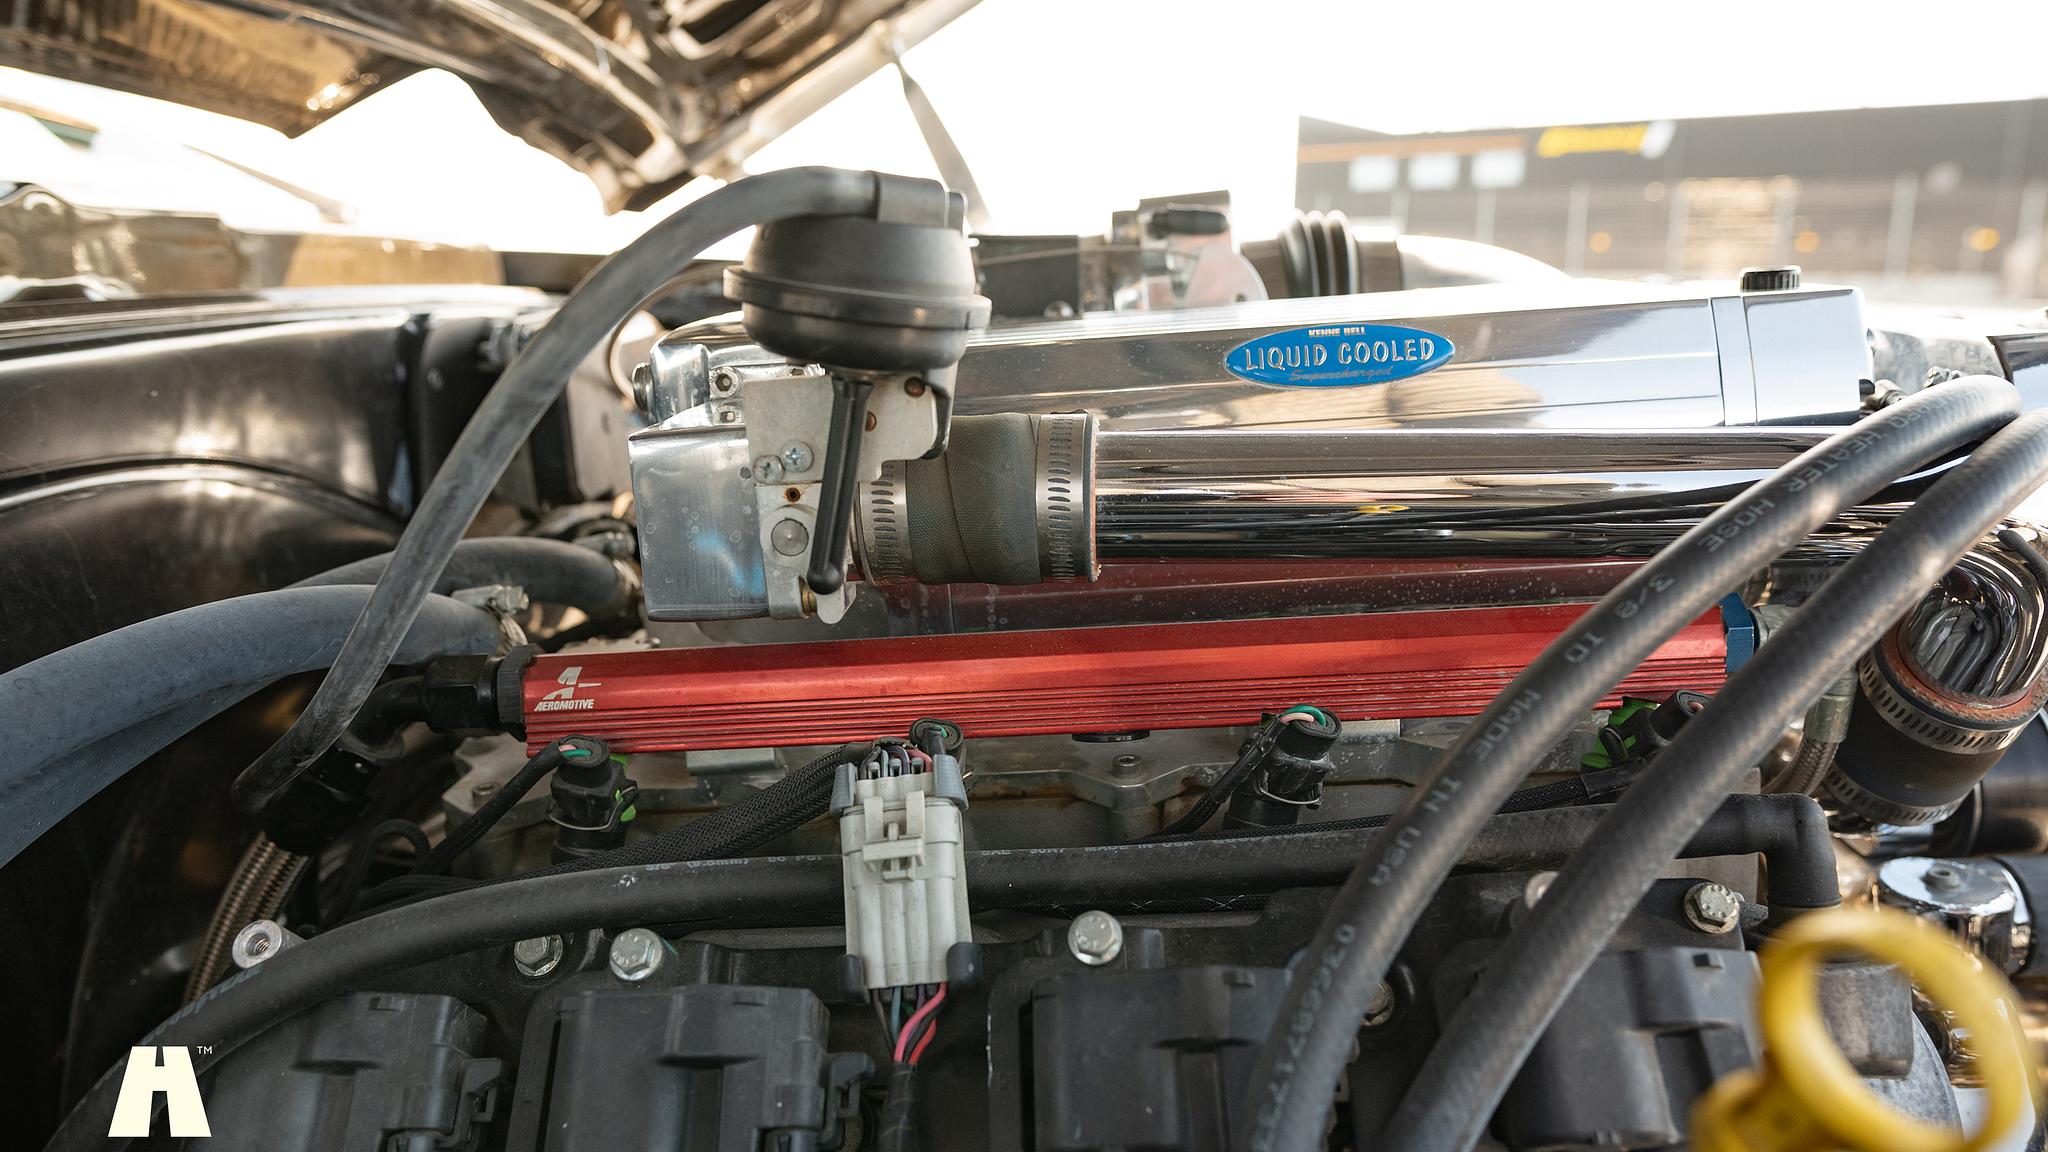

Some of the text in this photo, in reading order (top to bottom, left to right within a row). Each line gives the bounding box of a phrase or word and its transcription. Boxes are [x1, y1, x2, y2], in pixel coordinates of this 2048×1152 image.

[1308, 327, 1366, 337] KENNE BELL
[1245, 338, 1435, 371] LIQUID COOLED
[1781, 429, 1883, 494] HEATER
[1700, 498, 1776, 553] HOSE
[1616, 574, 1675, 619] 3/8
[1565, 633, 1602, 665] ID
[534, 698, 595, 712] AEROMOTIVE
[1476, 688, 1543, 762] MADE
[1424, 778, 1462, 814] IN
[1368, 826, 1422, 888] USA
